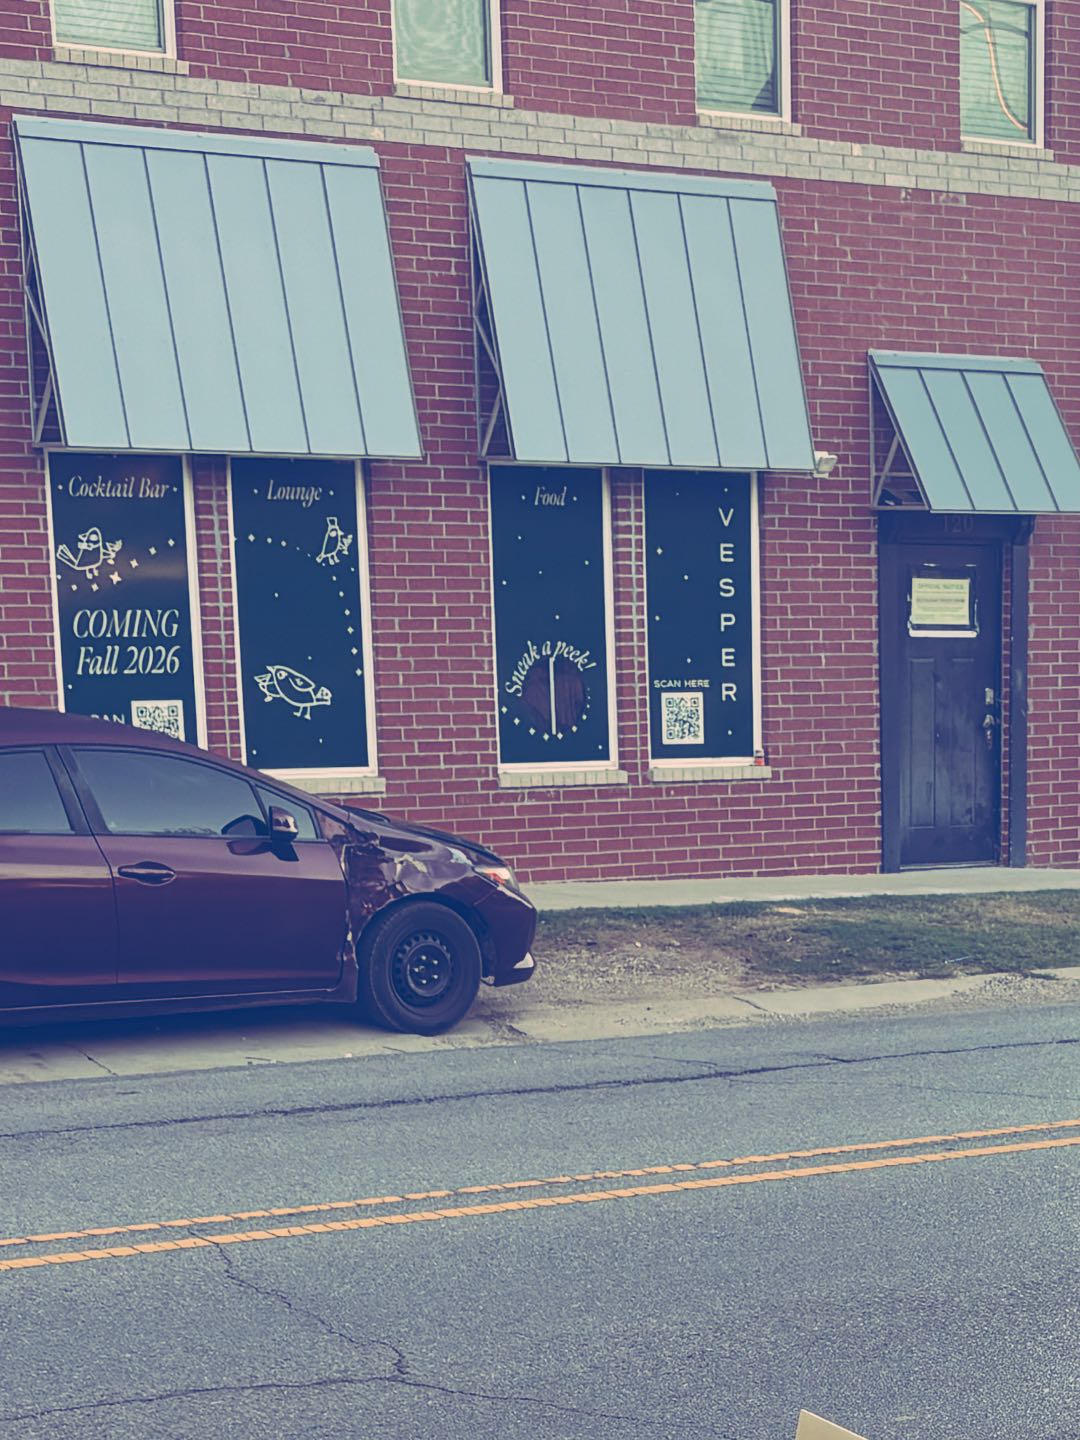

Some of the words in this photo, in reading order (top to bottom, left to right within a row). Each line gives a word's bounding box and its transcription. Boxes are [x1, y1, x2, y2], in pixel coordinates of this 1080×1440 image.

[68, 475, 135, 498] Cocktail
[139, 477, 169, 498] Bar
[267, 479, 323, 508] Lounge
[534, 486, 567, 506] Food
[718, 507, 737, 702] VESPER
[73, 609, 180, 639] COMING
[76, 645, 120, 675] Fall
[123, 645, 181, 674] 2026
[505, 640, 541, 697] Sneak
[541, 640, 552, 656] a
[552, 640, 597, 672] peek!
[653, 679, 682, 688] SCAN
[684, 679, 710, 688] HERE
